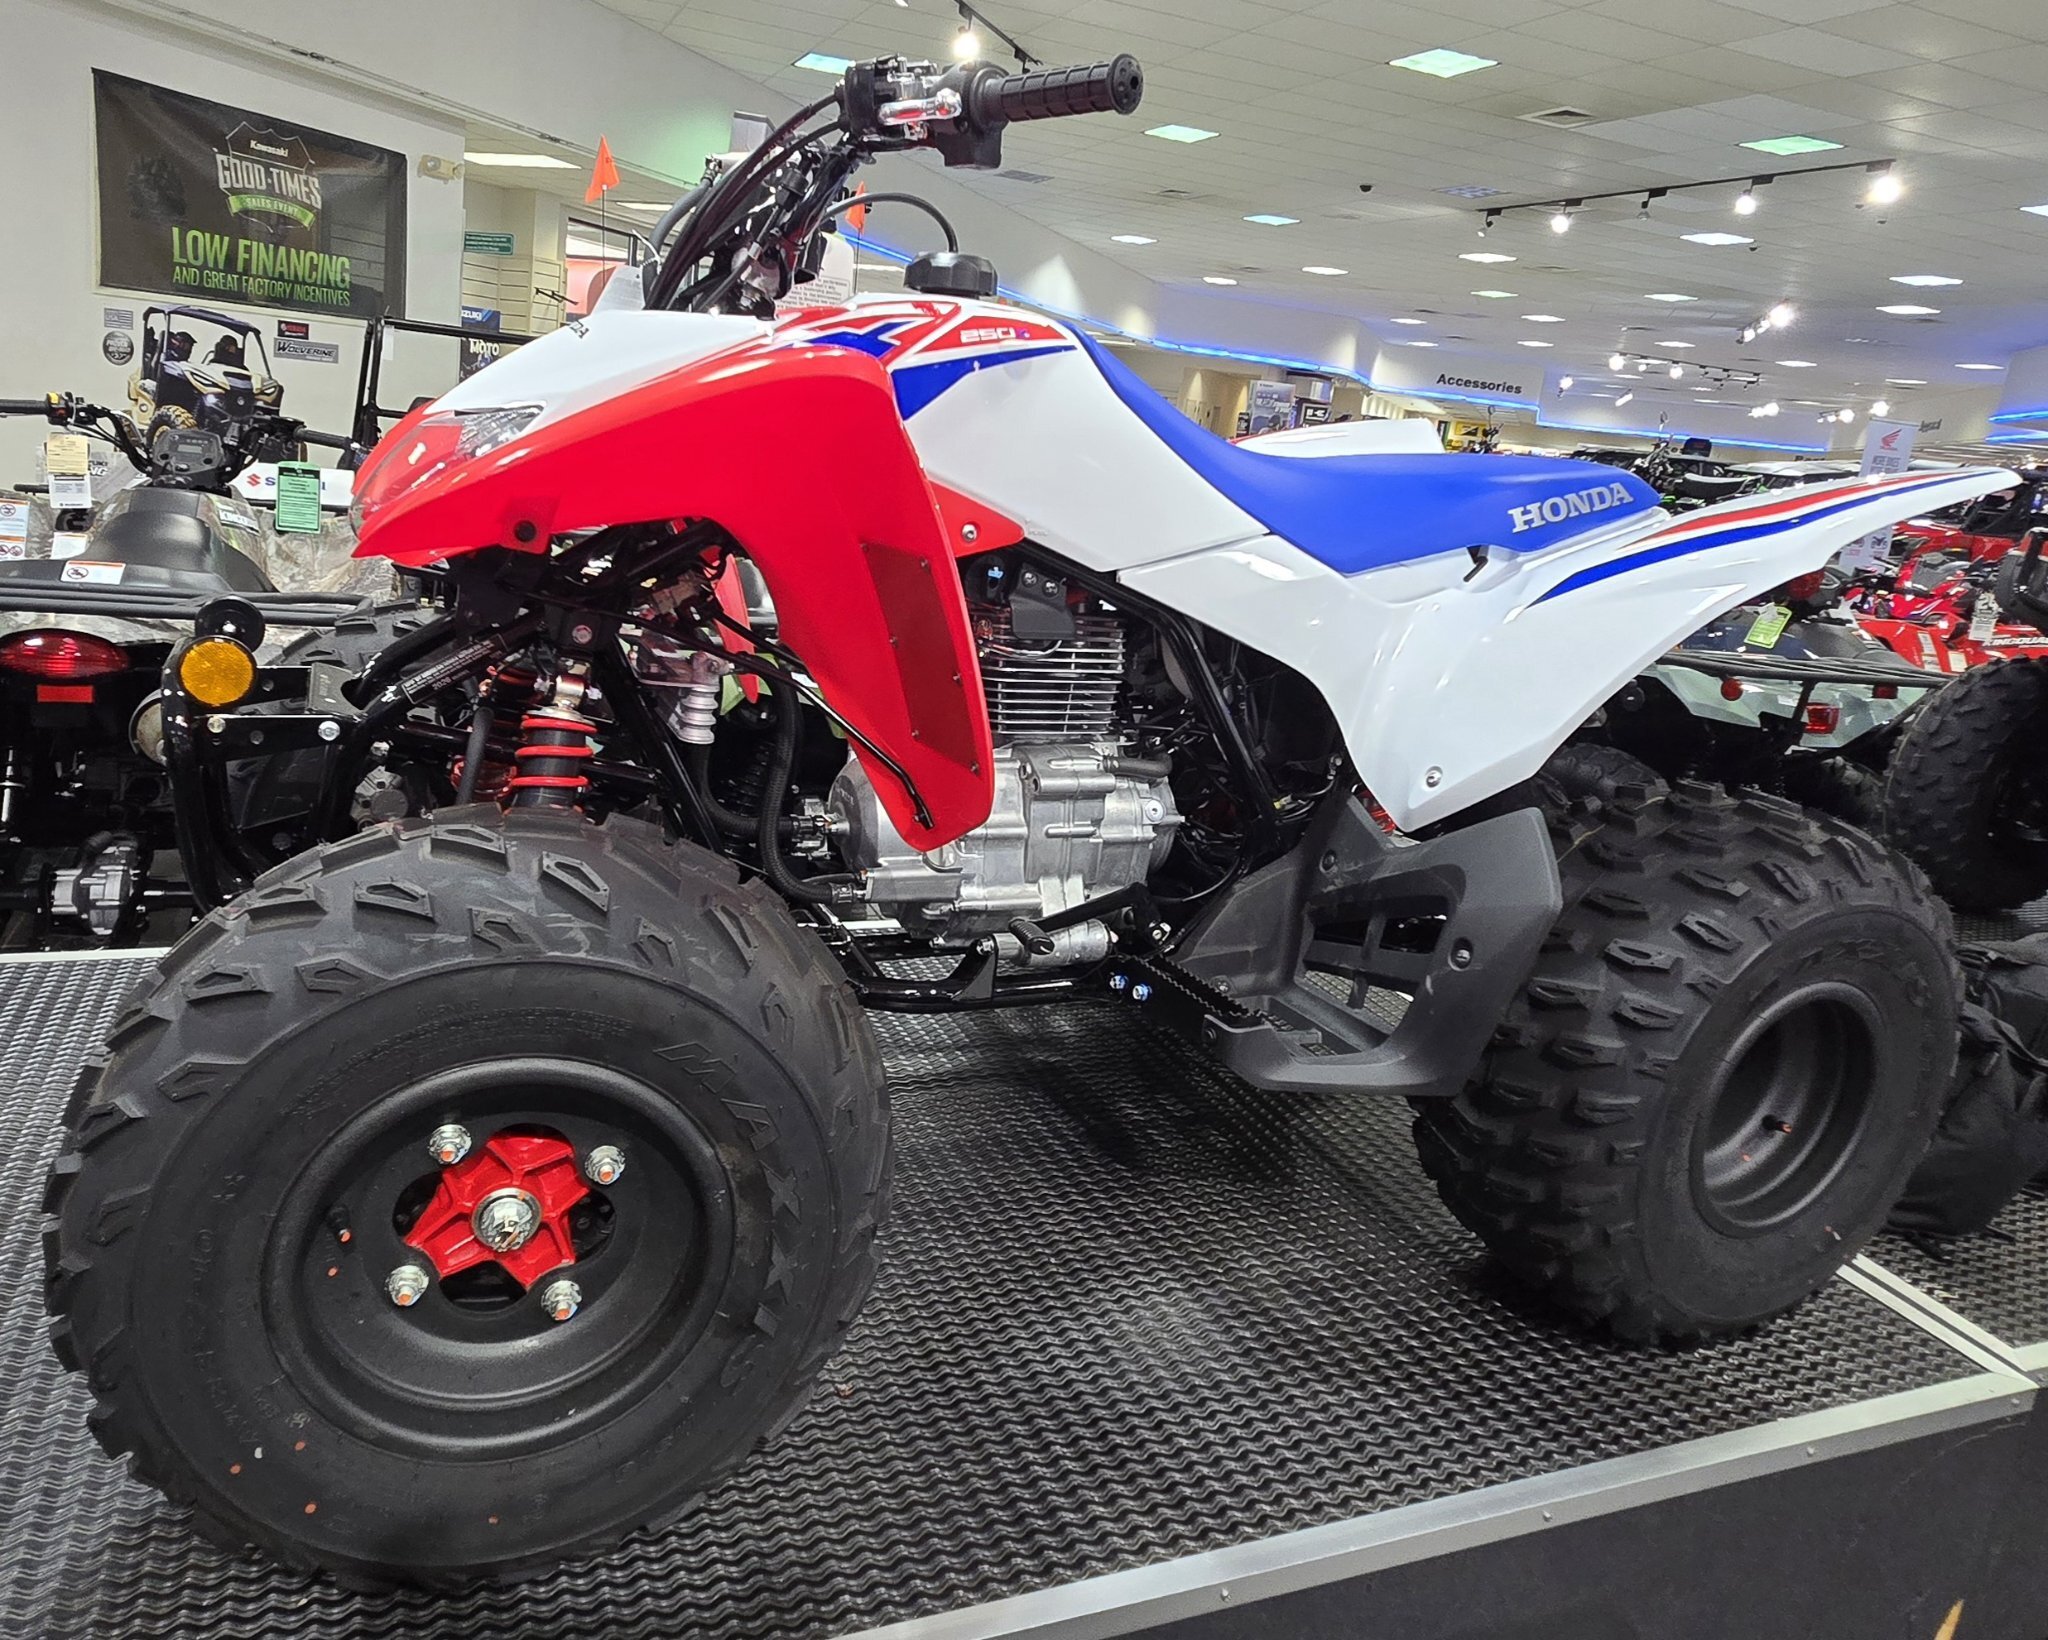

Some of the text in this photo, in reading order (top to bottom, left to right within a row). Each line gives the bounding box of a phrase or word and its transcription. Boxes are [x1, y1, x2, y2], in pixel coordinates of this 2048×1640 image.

[172, 226, 351, 289] LOW FINANCING
[172, 265, 351, 307] AND GREAT FACTORY INCENTIVES
[1436, 373, 1523, 394] Accessories
[1507, 482, 1634, 534] HONDA
